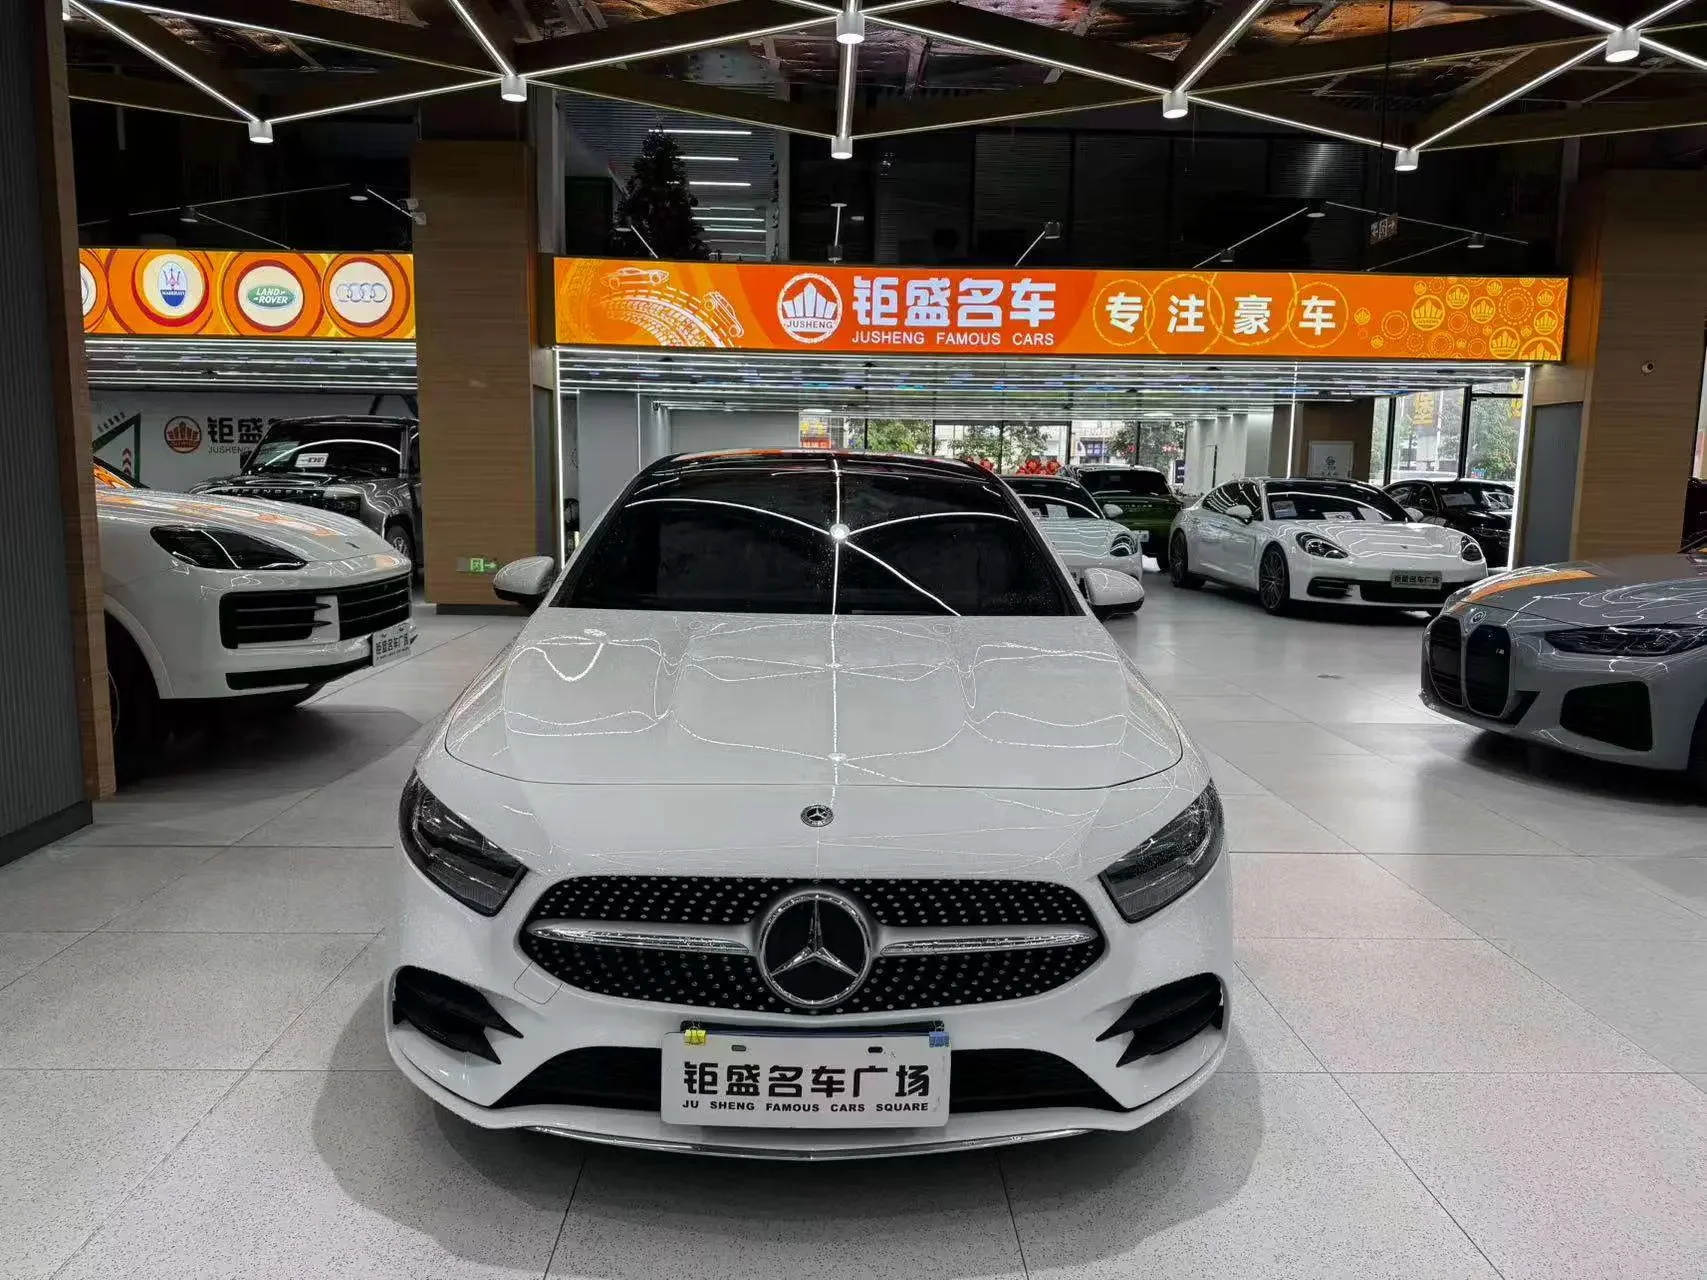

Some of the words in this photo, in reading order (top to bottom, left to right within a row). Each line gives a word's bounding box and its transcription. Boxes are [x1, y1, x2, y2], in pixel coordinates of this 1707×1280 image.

[256, 288, 281, 296] LAND
[258, 295, 289, 304] ROVER
[852, 276, 1057, 328] 钜盛名车
[1105, 291, 1337, 336] 专注豪车
[786, 319, 834, 330] JUSHENG
[852, 330, 925, 345] JUSHENG
[936, 332, 1001, 346] FAMOUS
[1012, 332, 1055, 346] CARS
[682, 1060, 931, 1098] 钜盛名车广场
[682, 1099, 700, 1109] JU
[710, 1100, 756, 1111] SHENG
[765, 1103, 820, 1112] FAMOUS
[830, 1103, 866, 1112] CARS
[876, 1102, 930, 1112] SQUARE
